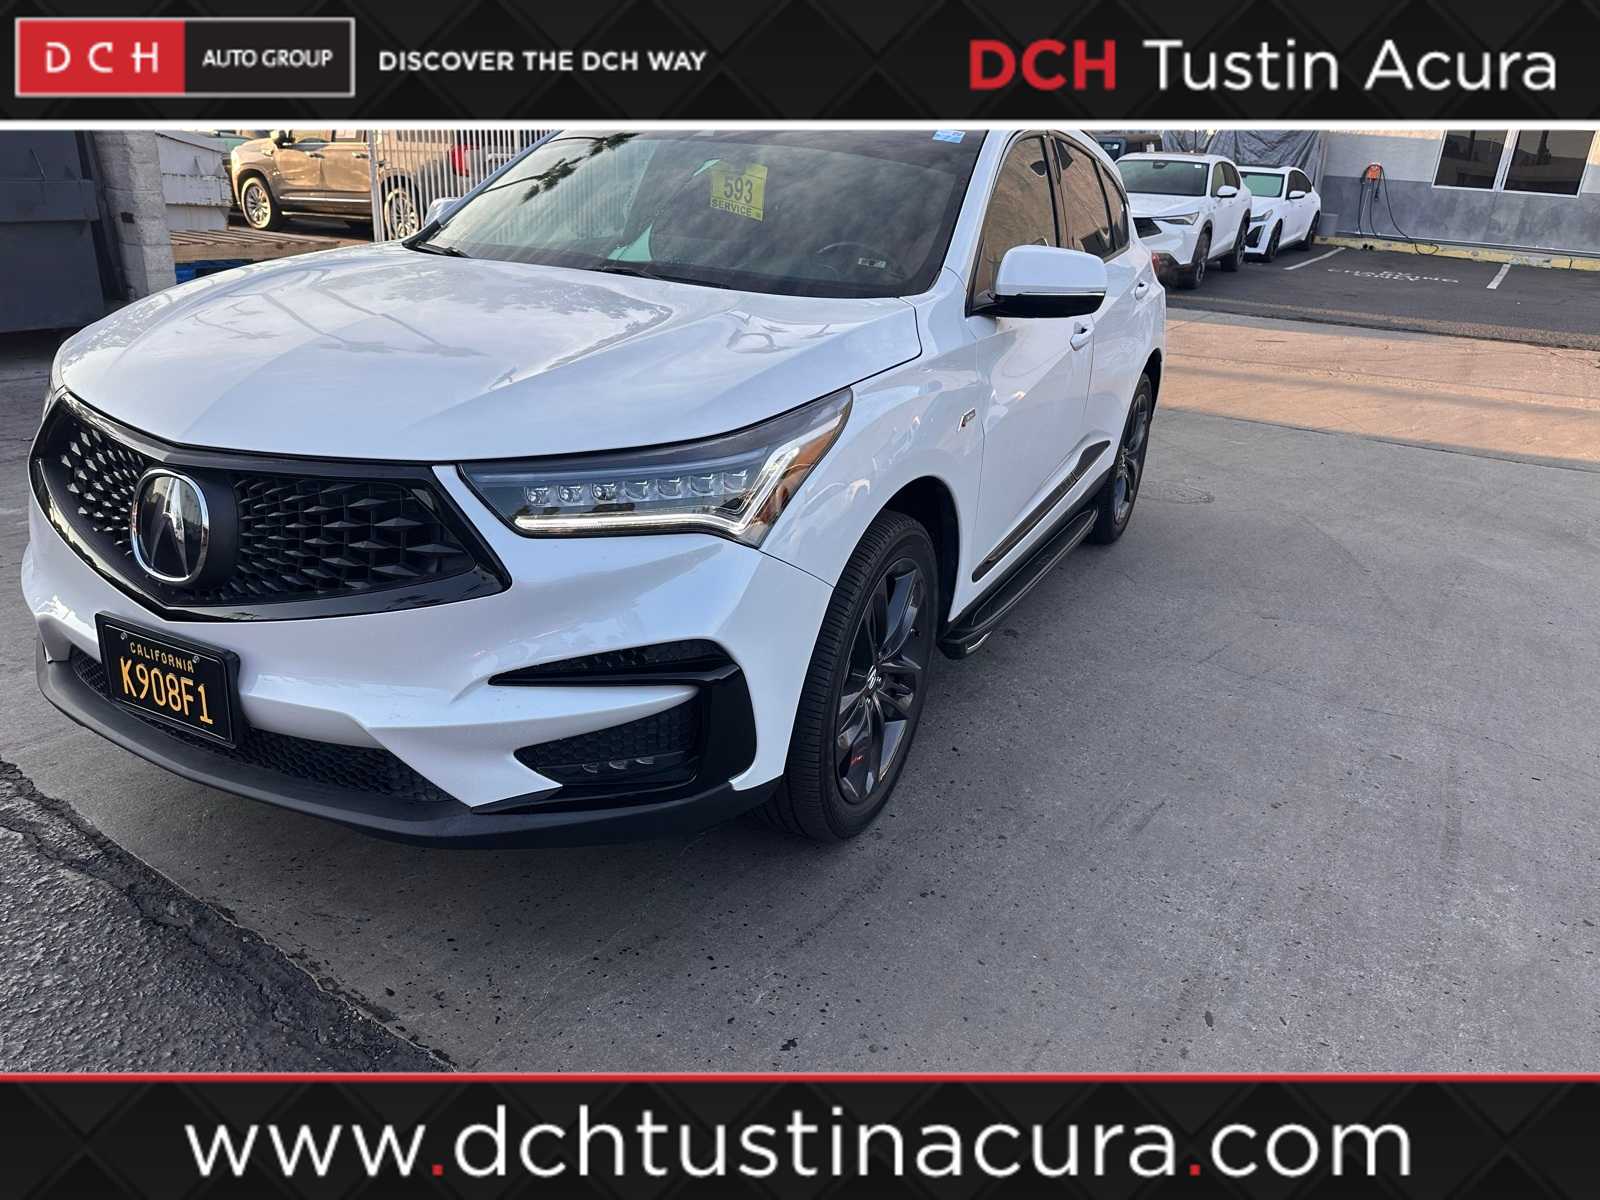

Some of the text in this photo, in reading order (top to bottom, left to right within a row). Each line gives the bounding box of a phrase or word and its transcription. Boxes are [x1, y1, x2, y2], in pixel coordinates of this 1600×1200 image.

[723, 176, 753, 204] 593
[711, 199, 753, 217] SERVICE
[129, 641, 195, 674] CALIFORNIA
[119, 655, 214, 725] K908F1
